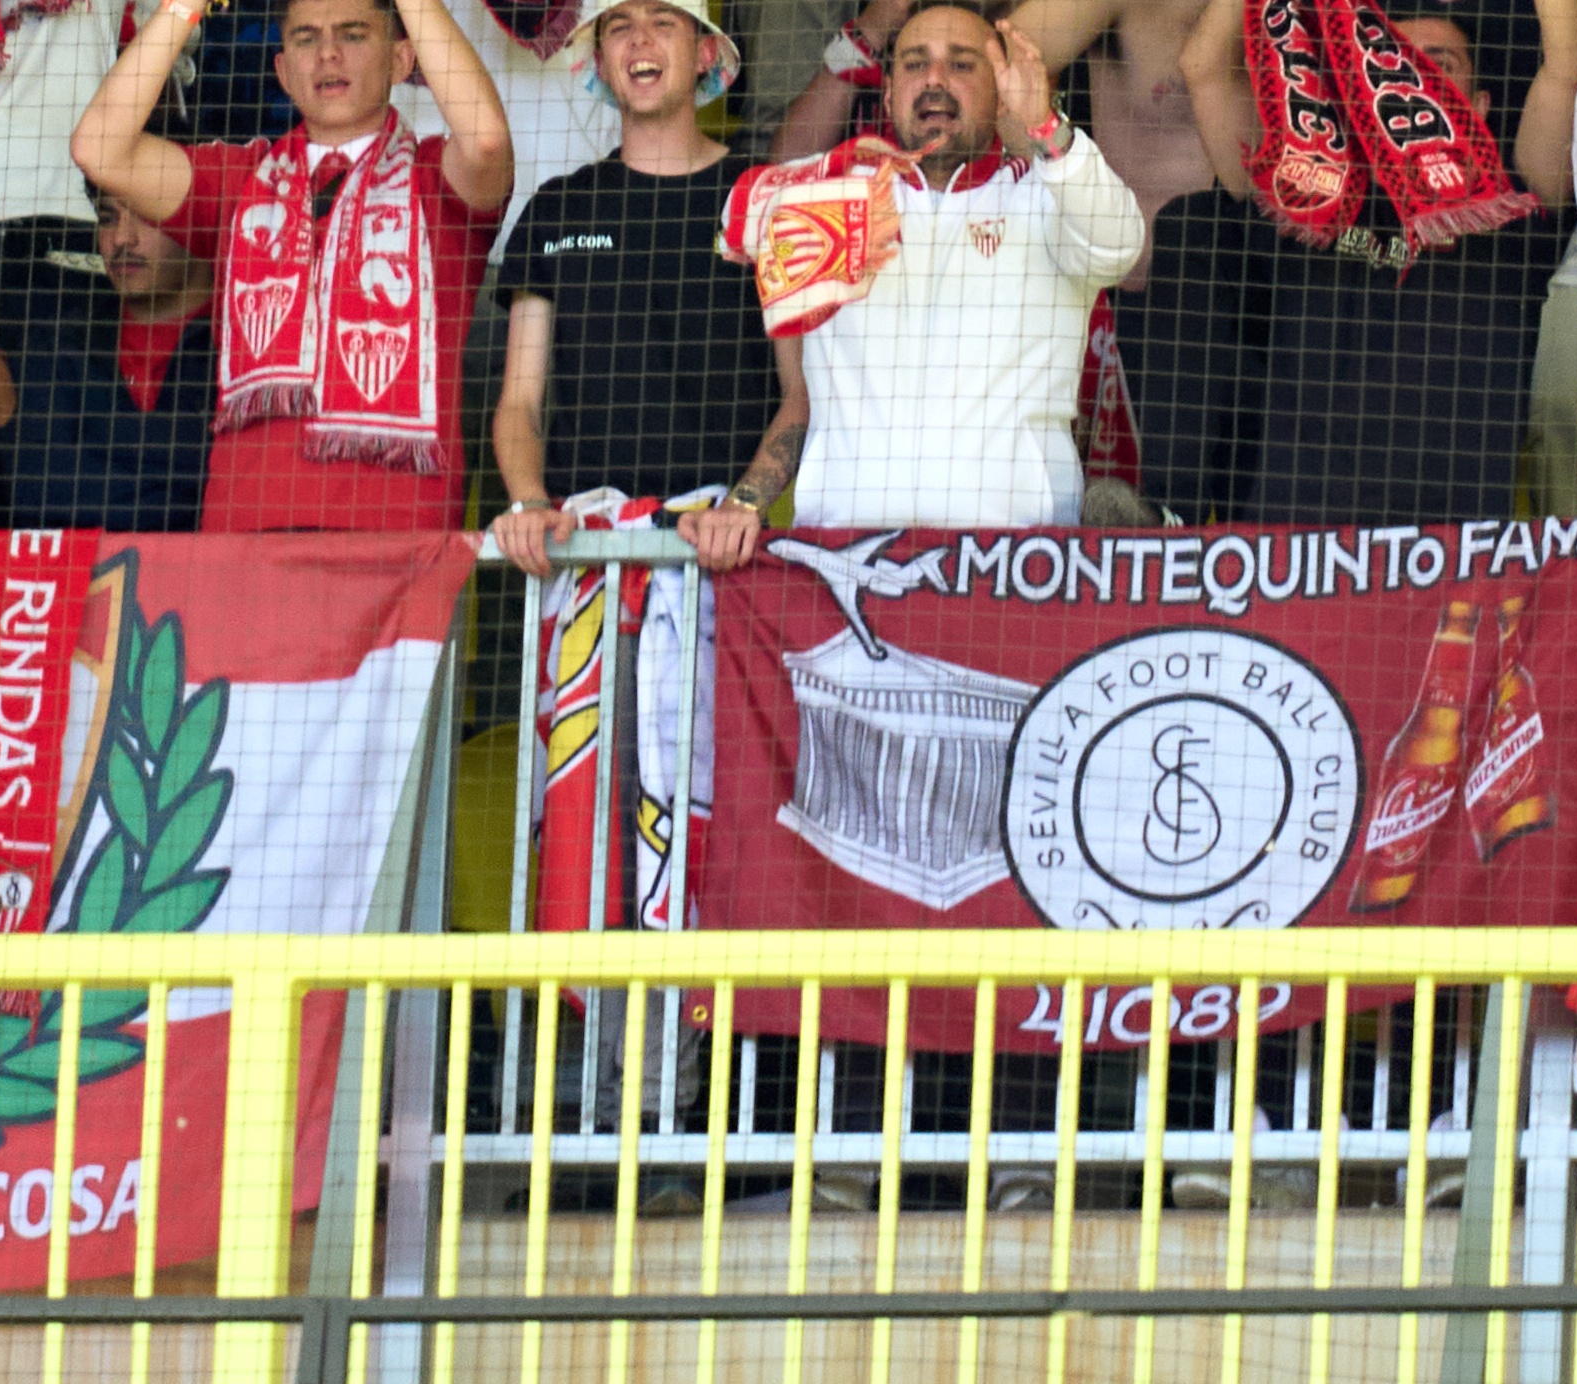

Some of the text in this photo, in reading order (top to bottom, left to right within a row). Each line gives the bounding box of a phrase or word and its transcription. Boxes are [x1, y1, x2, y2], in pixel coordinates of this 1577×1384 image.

[577, 234, 614, 250] COPA
[1032, 704, 1091, 869] SEVILLA
[1300, 753, 1342, 864] CLUB
